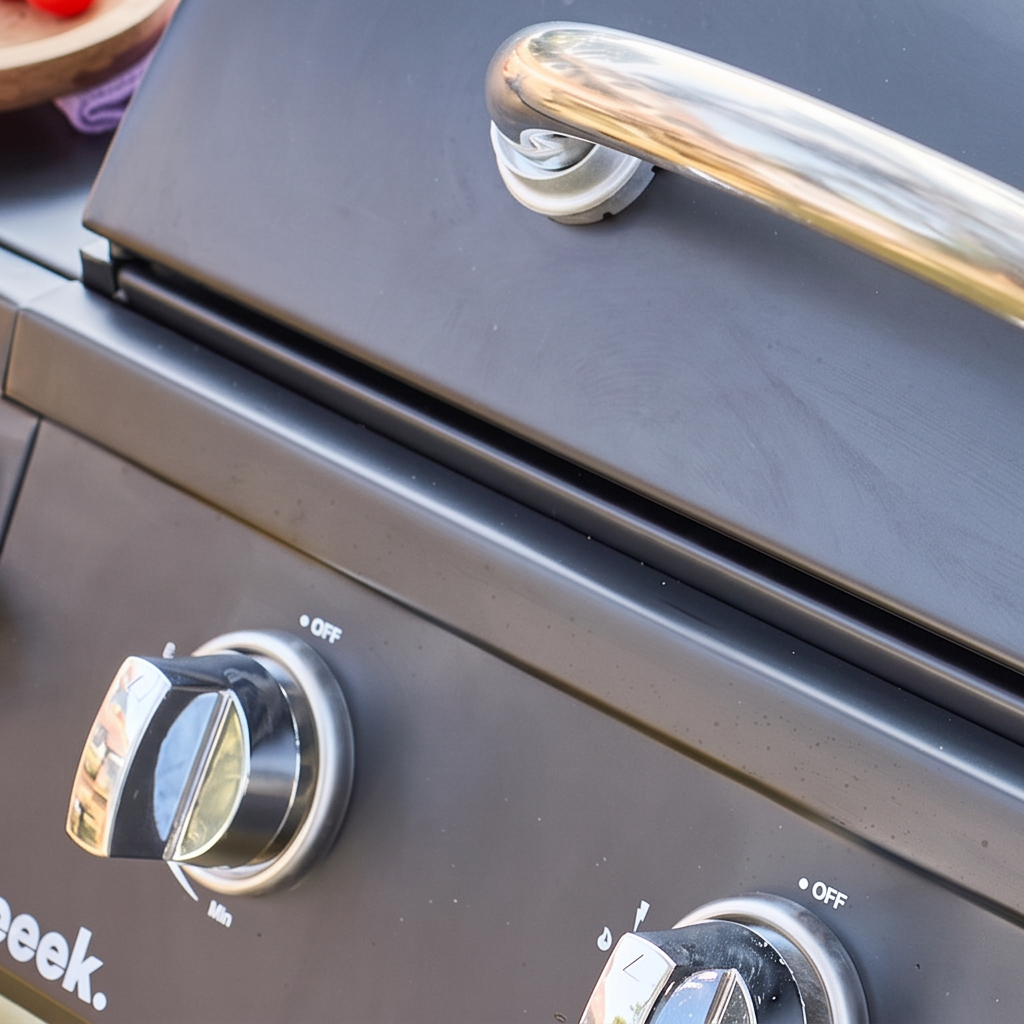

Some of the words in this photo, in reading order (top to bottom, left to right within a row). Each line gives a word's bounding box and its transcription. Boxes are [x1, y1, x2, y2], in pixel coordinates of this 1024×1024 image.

[311, 617, 343, 645] OFF
[811, 881, 848, 910] OFF
[207, 899, 234, 928] Min
